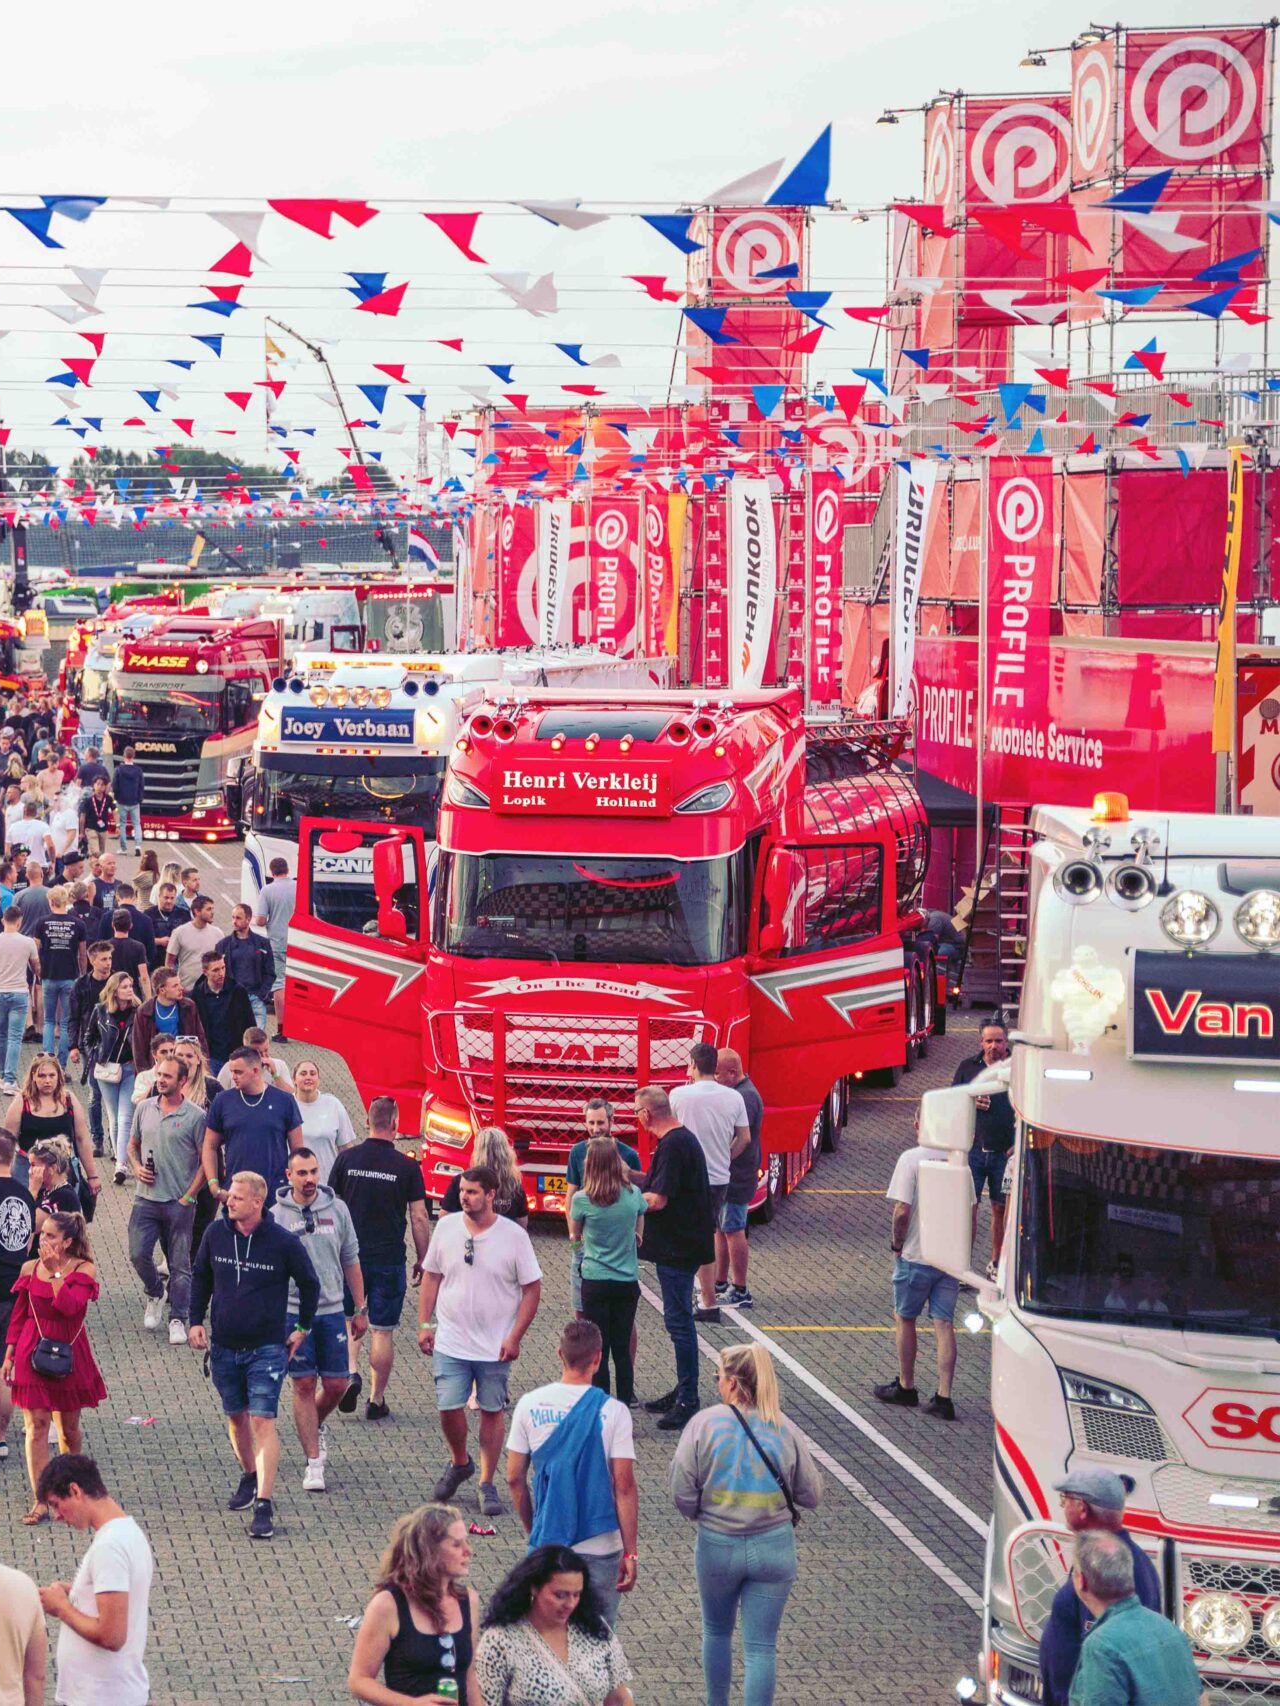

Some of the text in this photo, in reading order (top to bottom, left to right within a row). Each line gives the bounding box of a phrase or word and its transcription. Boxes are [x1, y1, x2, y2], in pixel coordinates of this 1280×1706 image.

[992, 555, 1036, 708] PROFILE
[128, 655, 189, 668] FAASSE
[131, 681, 186, 690] TRANSPORT
[922, 685, 973, 748] PROFILE
[284, 717, 411, 739] Joey Verbaan
[134, 742, 177, 753] SCANIA
[990, 722, 1103, 769] Mobiele Service
[502, 771, 658, 794] Henri Verkleij
[503, 795, 657, 808] Lopik Holland
[516, 979, 640, 997] On The Road
[1145, 988, 1273, 1037] Van
[534, 1042, 620, 1062] DAF
[365, 1171, 398, 1182] LINTHORST
[214, 1255, 237, 1264] TOMMY
[245, 1262, 274, 1271] HILFIGER
